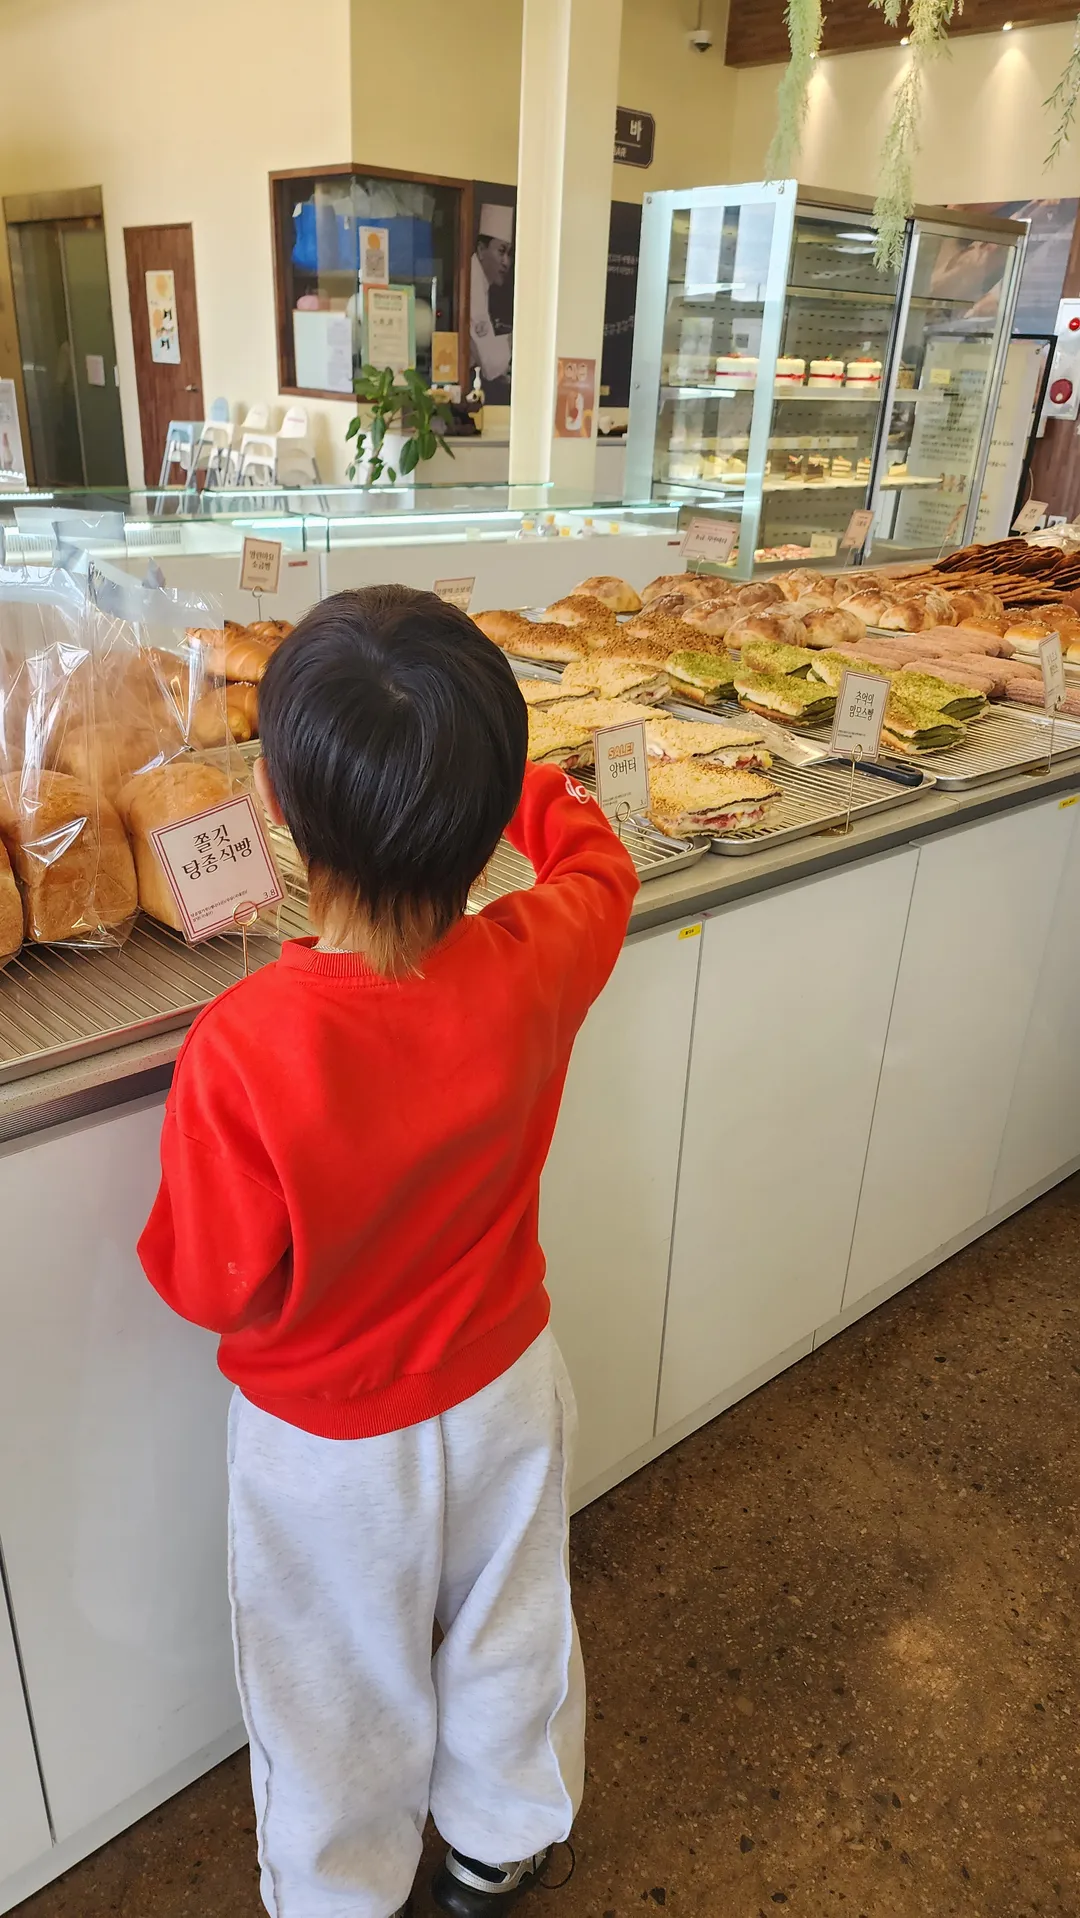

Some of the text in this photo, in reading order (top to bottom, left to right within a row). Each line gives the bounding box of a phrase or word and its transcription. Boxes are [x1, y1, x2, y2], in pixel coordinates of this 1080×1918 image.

[629, 120, 642, 142] 바
[855, 690, 875, 706] 추억의
[849, 705, 874, 721] 맘모스빵
[608, 741, 635, 760] SALE!
[609, 757, 637, 779] 앙버터
[193, 824, 231, 854] 쫄깃
[181, 837, 253, 880] 탕종식빵
[263, 888, 276, 900] 3.8
